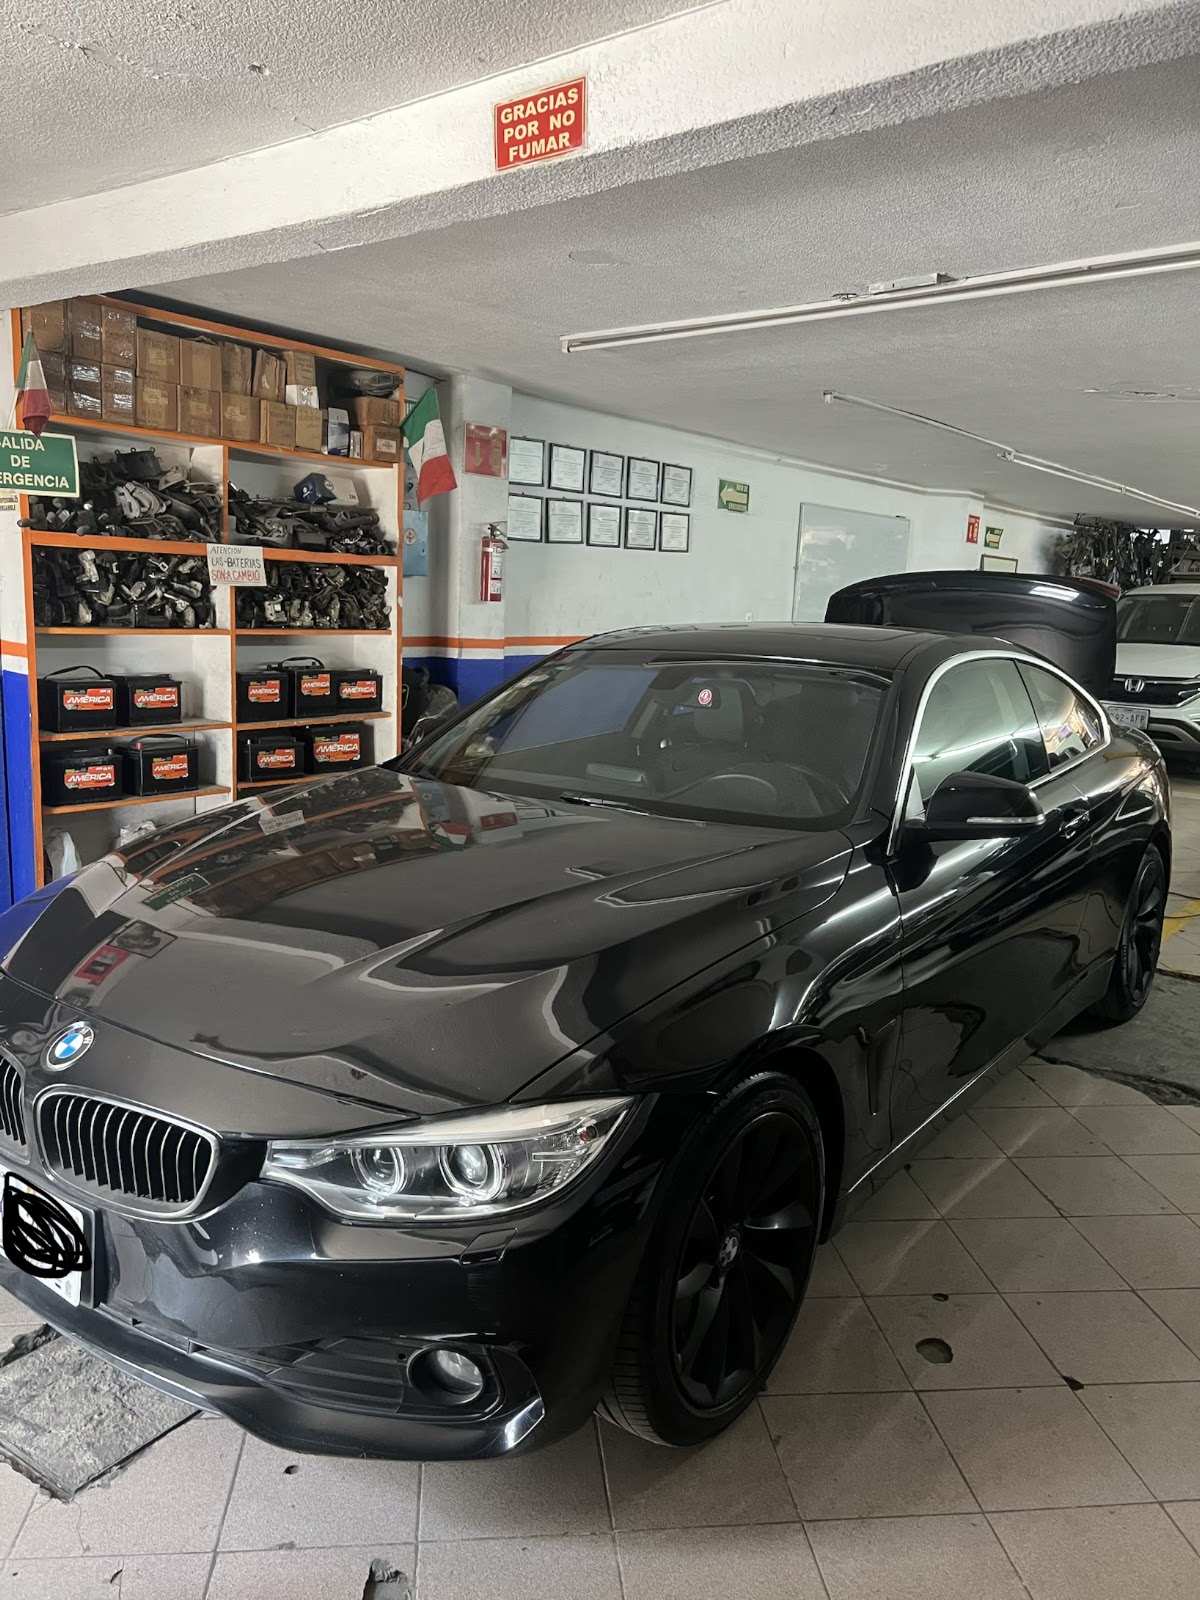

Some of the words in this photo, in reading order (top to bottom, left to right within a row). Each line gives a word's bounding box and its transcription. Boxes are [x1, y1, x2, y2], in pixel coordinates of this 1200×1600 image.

[500, 87, 578, 124] GRACIAS
[503, 120, 539, 144] POR
[549, 109, 575, 131] NO
[509, 131, 570, 162] FUMAR
[0, 436, 45, 451] ALIDA
[10, 454, 30, 468] DE
[232, 570, 260, 582] CAMBIO
